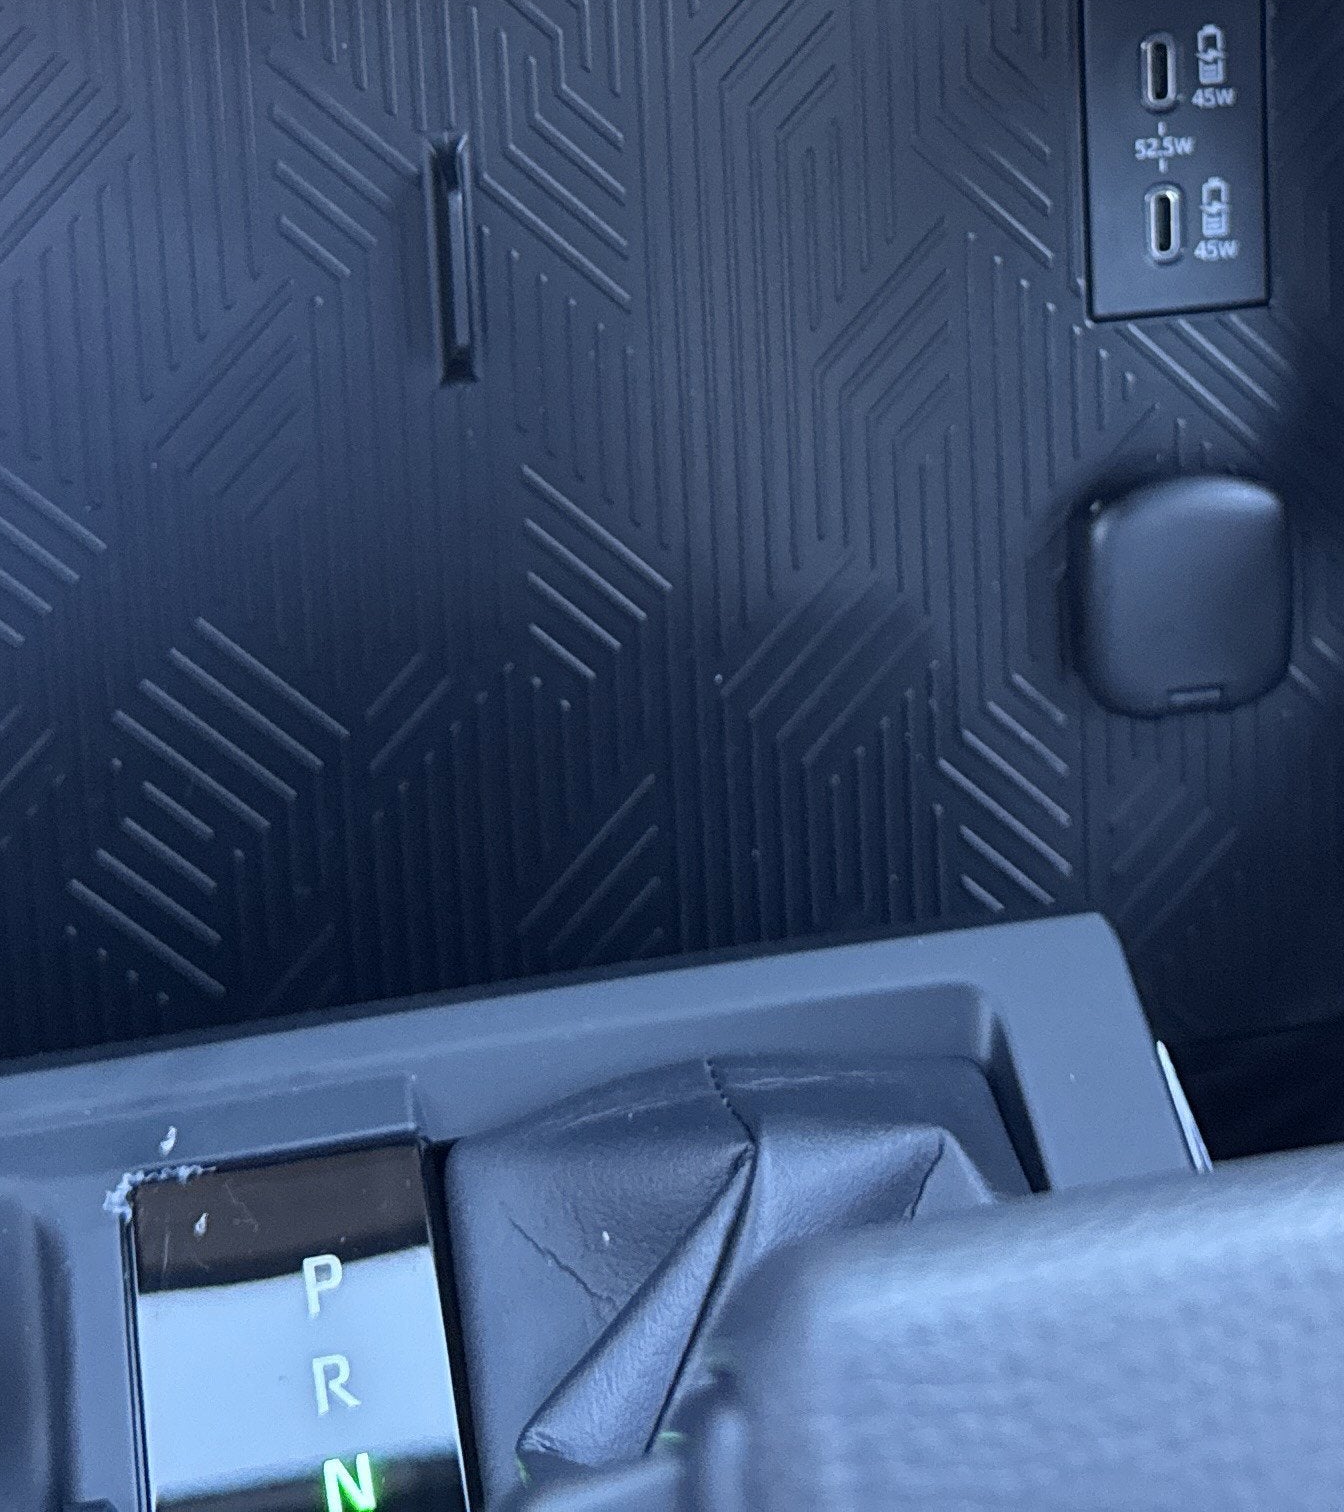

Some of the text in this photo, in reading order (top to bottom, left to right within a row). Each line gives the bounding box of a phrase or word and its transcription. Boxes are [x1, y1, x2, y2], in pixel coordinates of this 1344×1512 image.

[1191, 87, 1236, 109] 45W
[1193, 239, 1239, 262] 45W
[302, 1253, 344, 1319] P
[312, 1353, 362, 1416] R
[323, 1452, 377, 1512] N
